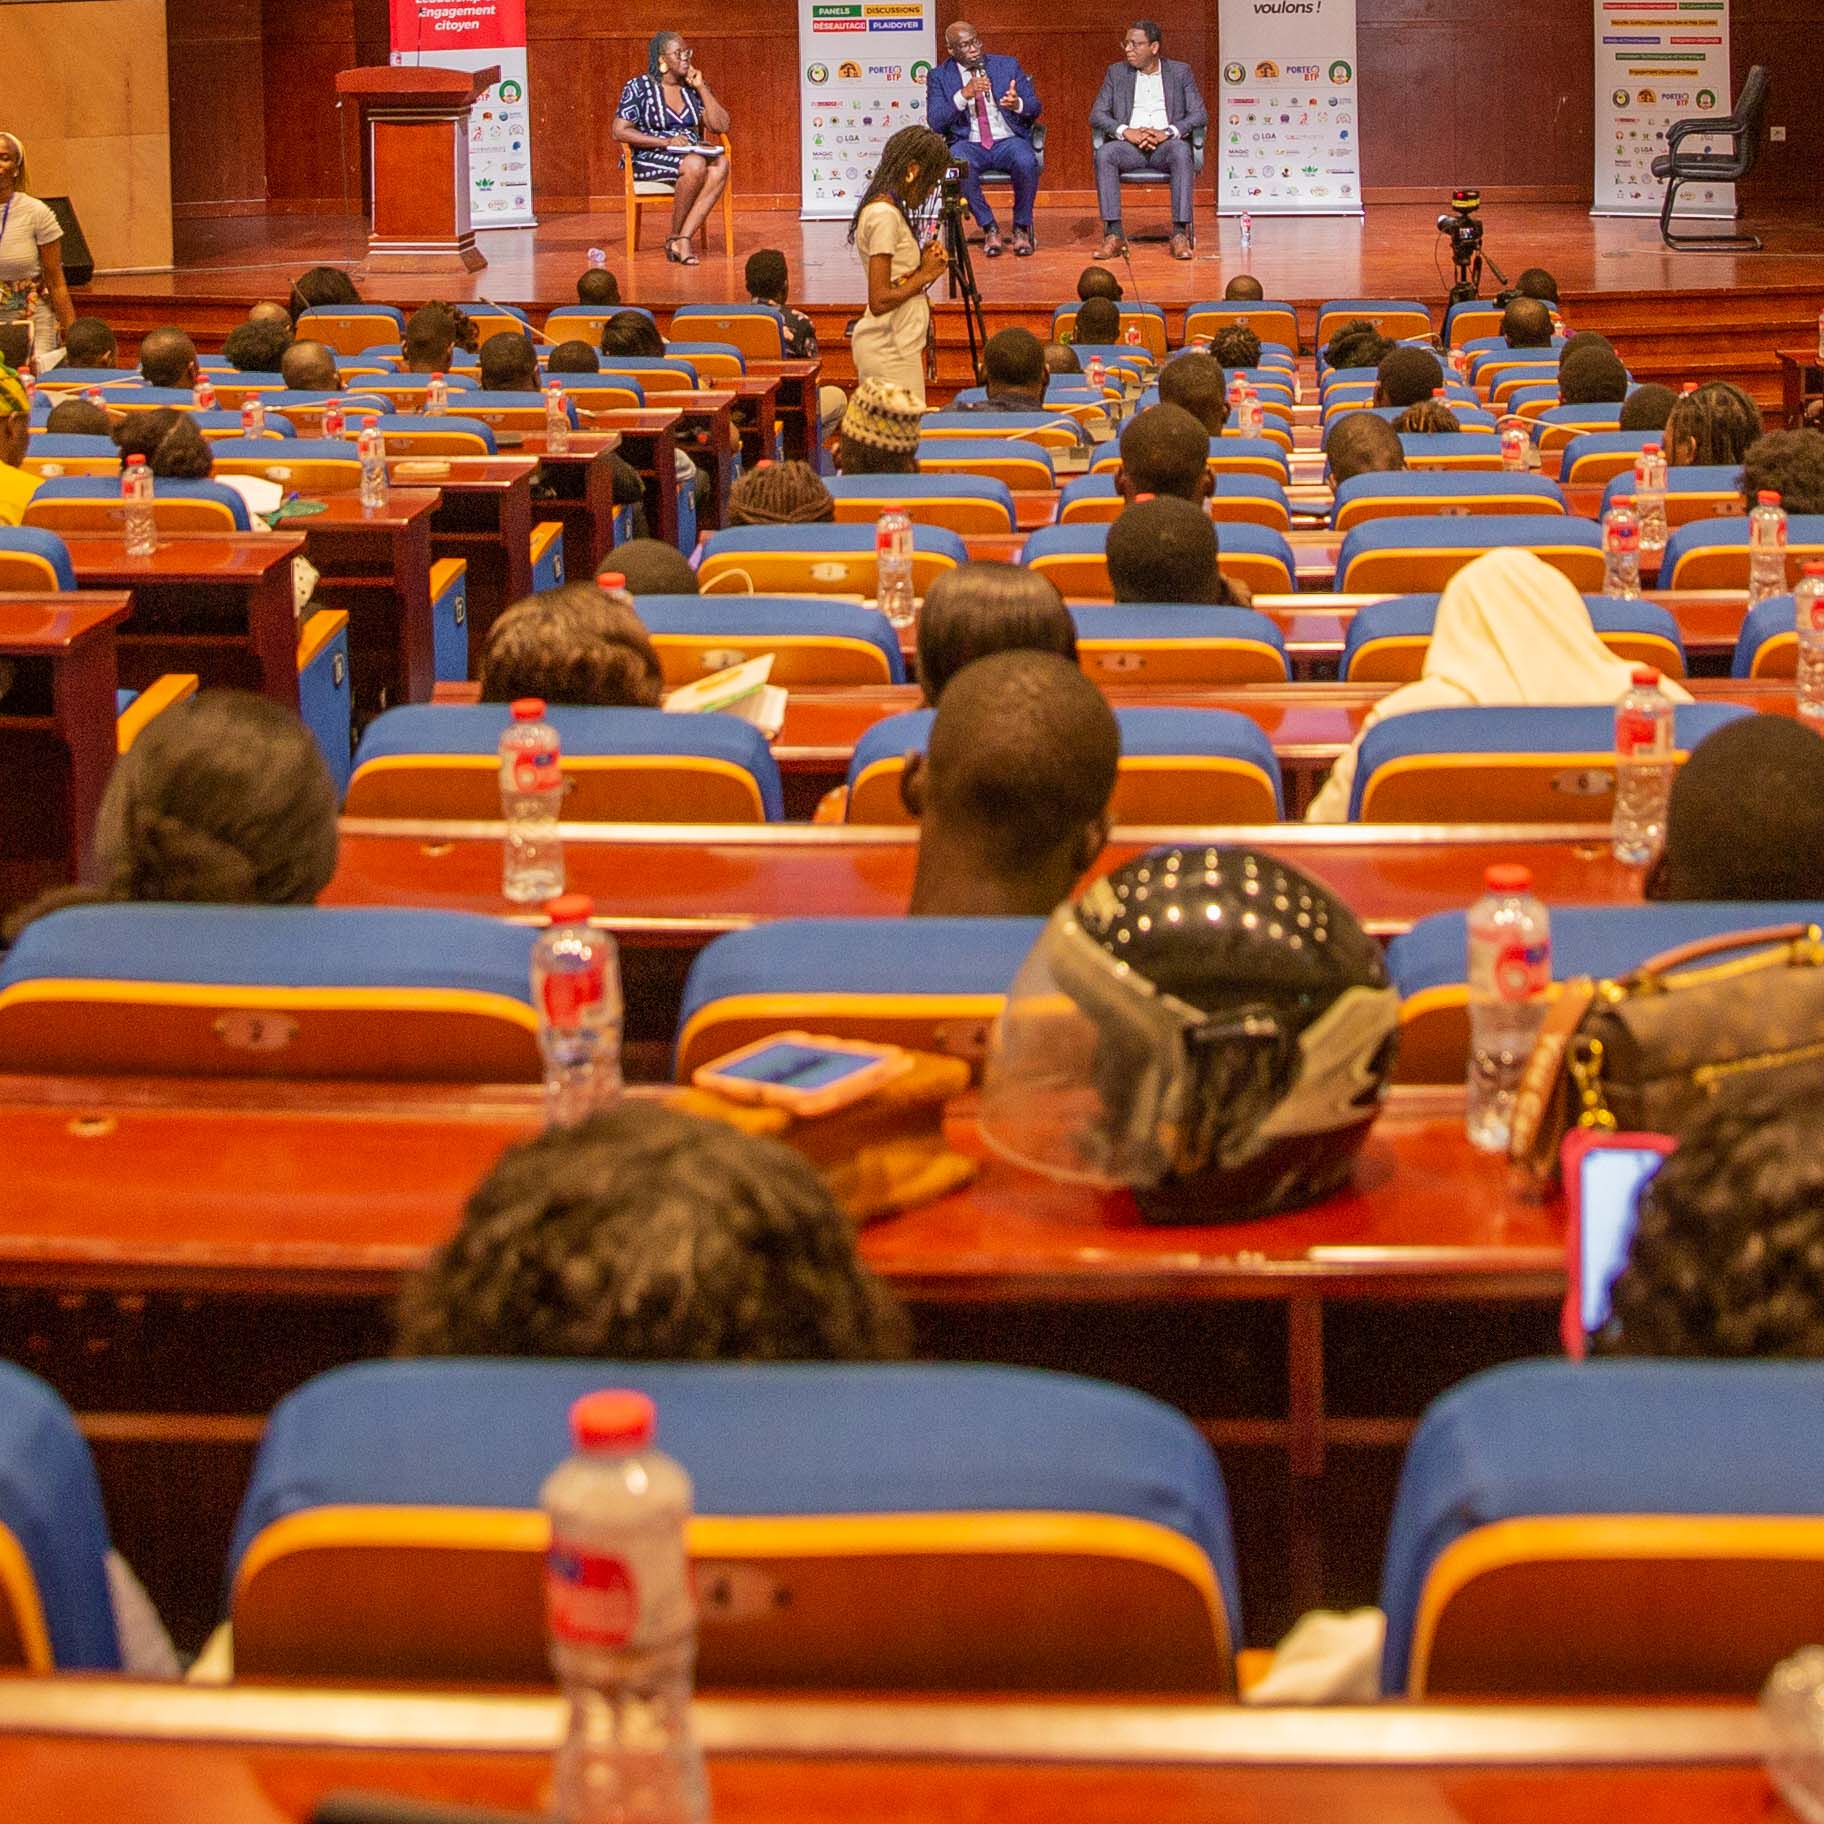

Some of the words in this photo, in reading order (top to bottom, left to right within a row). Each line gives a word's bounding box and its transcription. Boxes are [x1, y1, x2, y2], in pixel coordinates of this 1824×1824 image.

[819, 7, 850, 16] PANELS
[866, 6, 920, 15] DISCUSSIONS
[1254, 0, 1314, 14] voulons
[435, 20, 480, 33] citoyen
[873, 20, 919, 30] PLAIDOYER
